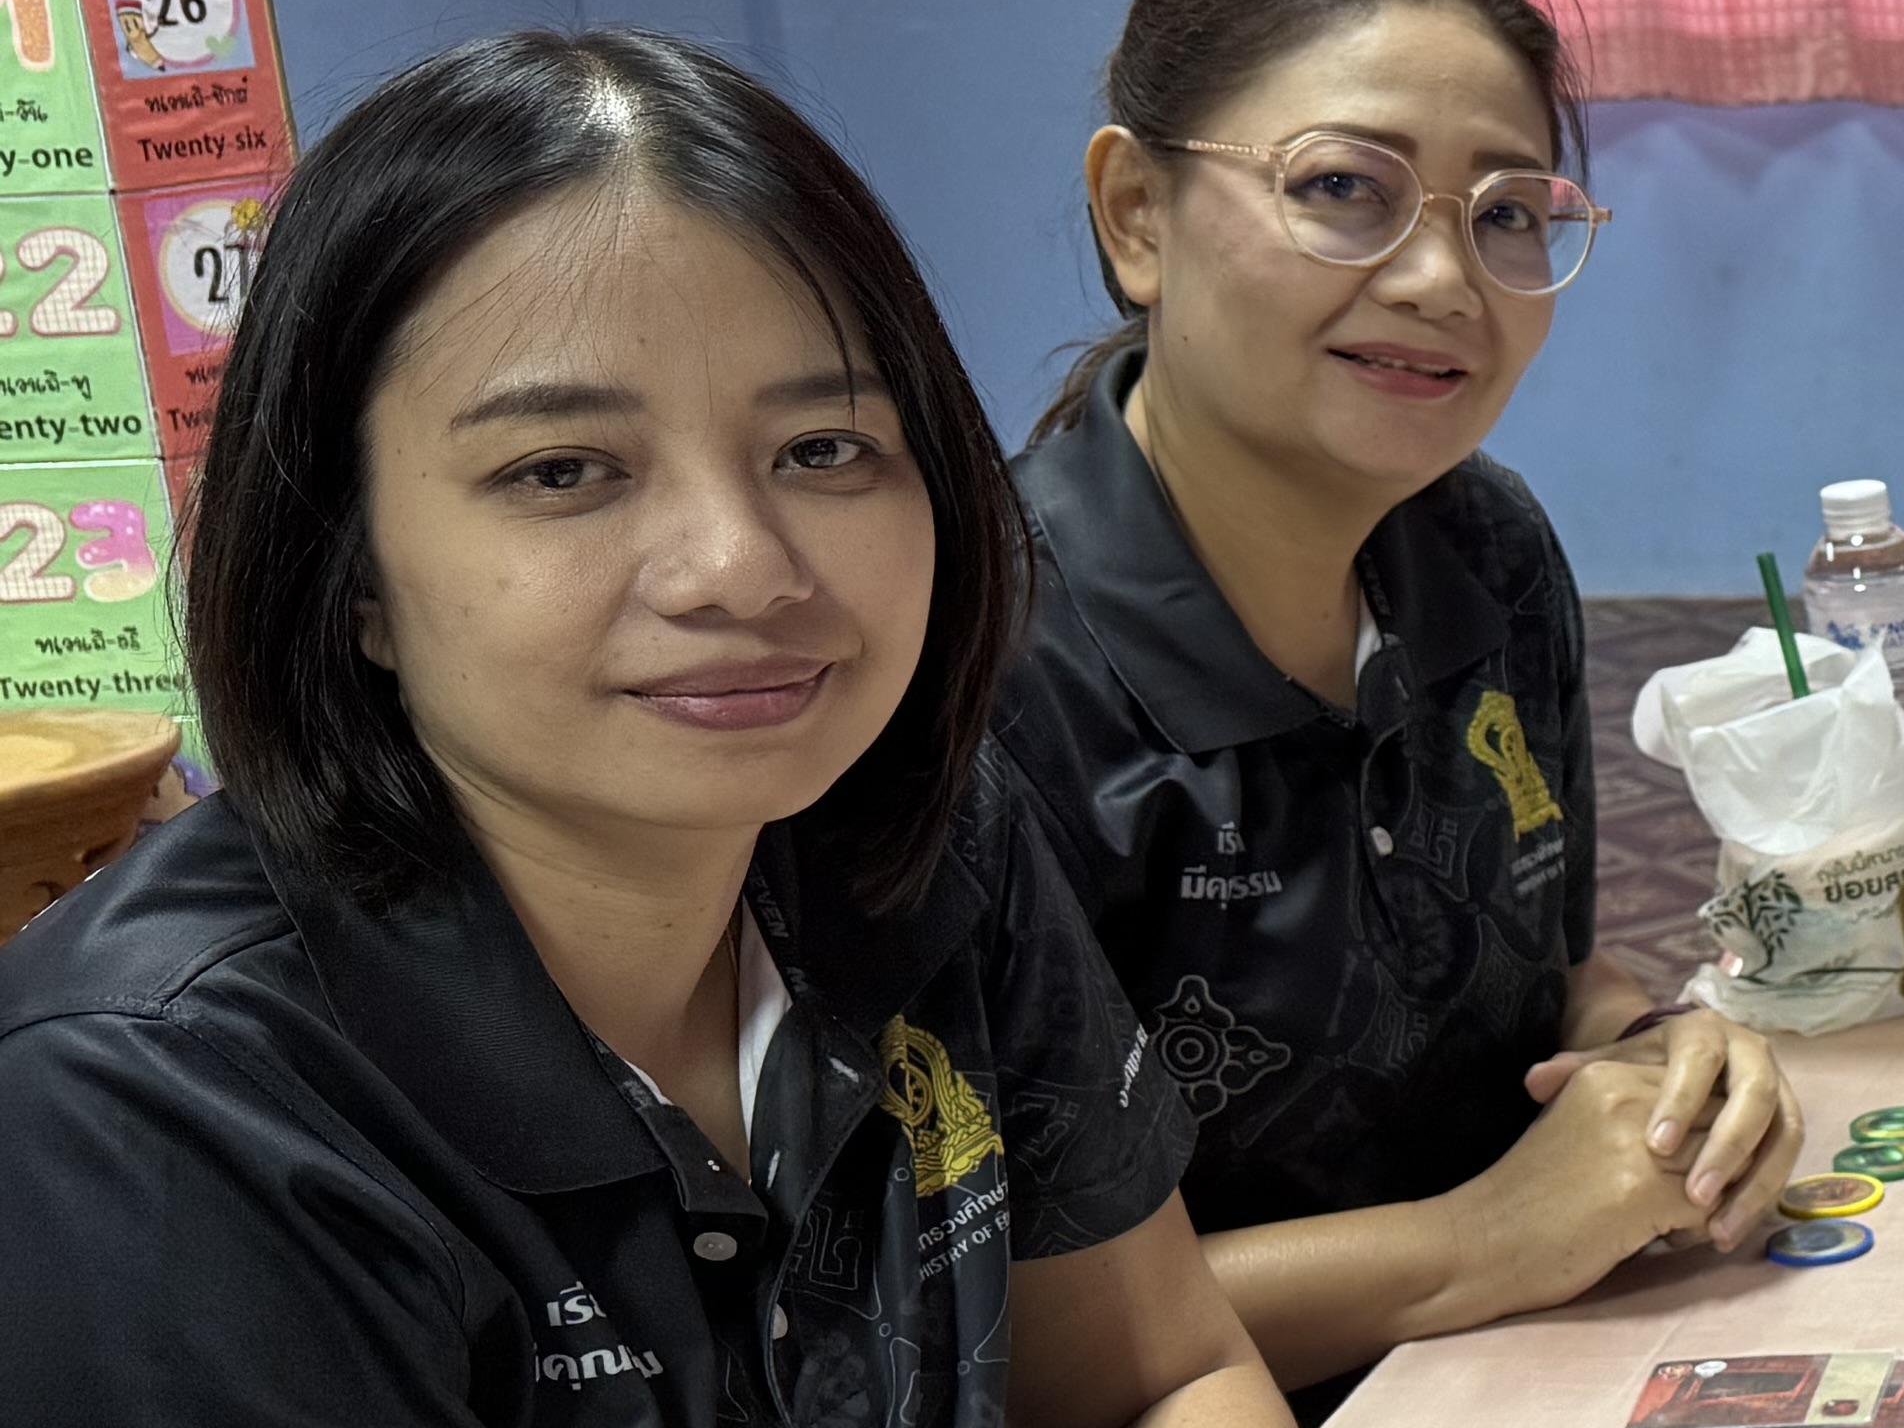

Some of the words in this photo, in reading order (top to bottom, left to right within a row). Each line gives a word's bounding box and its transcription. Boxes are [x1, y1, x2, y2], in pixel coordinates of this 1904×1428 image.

[0, 226, 121, 339] 2
[0, 499, 160, 604] 23
[971, 1224, 993, 1245] OF
